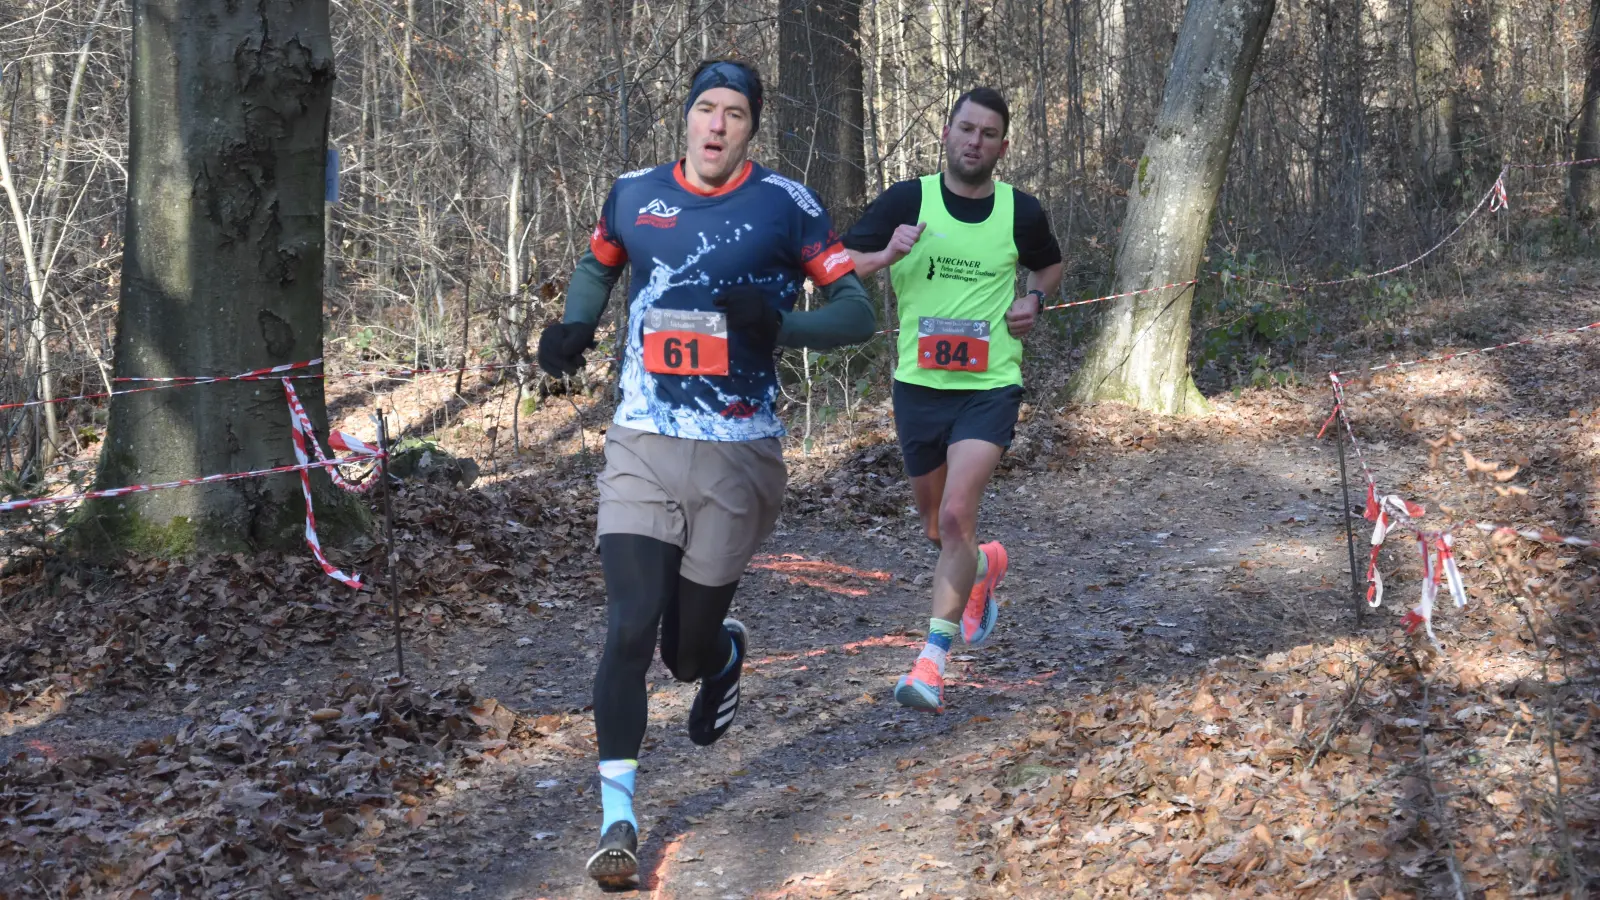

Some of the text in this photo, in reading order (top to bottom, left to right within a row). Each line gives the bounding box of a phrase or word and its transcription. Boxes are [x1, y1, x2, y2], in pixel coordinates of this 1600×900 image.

[936, 255, 981, 269] KIRCHNER
[939, 272, 978, 283] Nördlingen
[663, 337, 699, 369] 61
[935, 340, 969, 367] 84
